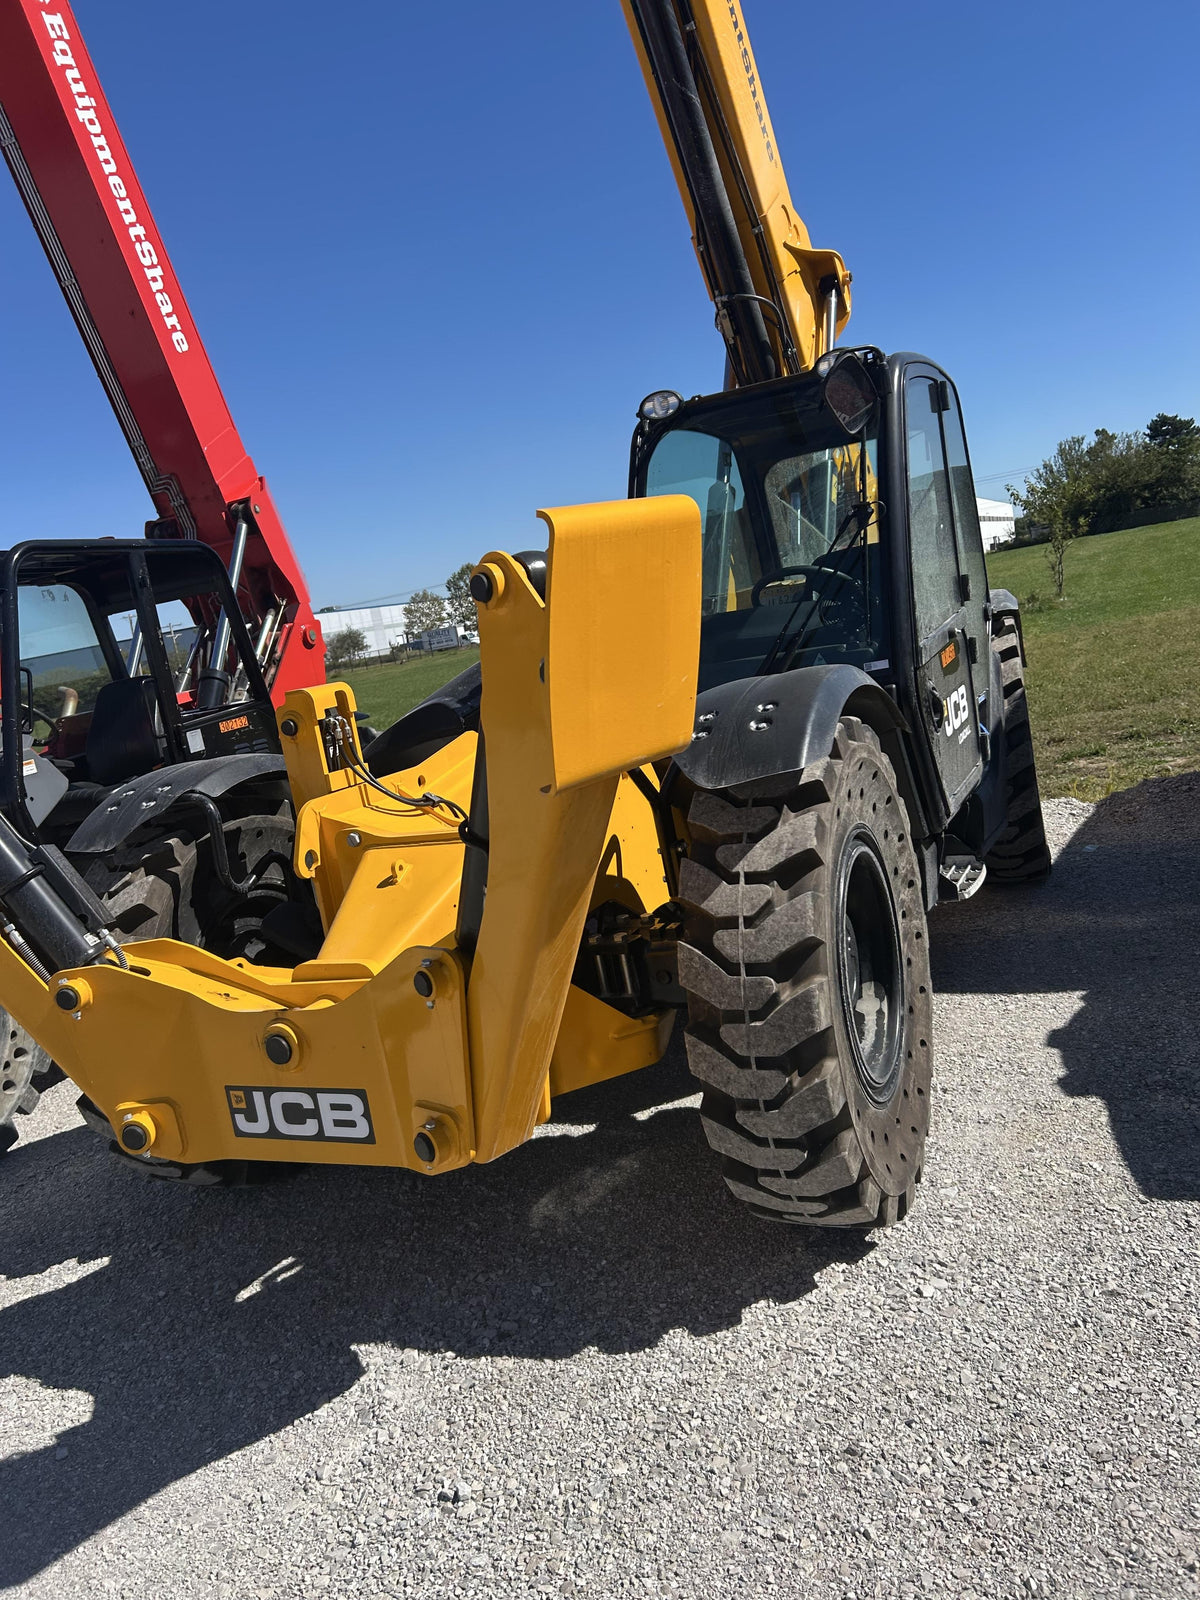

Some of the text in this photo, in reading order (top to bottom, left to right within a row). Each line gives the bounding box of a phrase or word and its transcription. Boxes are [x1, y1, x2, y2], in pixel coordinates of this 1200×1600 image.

[41, 11, 190, 354] EquipmentShare
[944, 684, 969, 738] JCB
[234, 1090, 371, 1139] JCB
